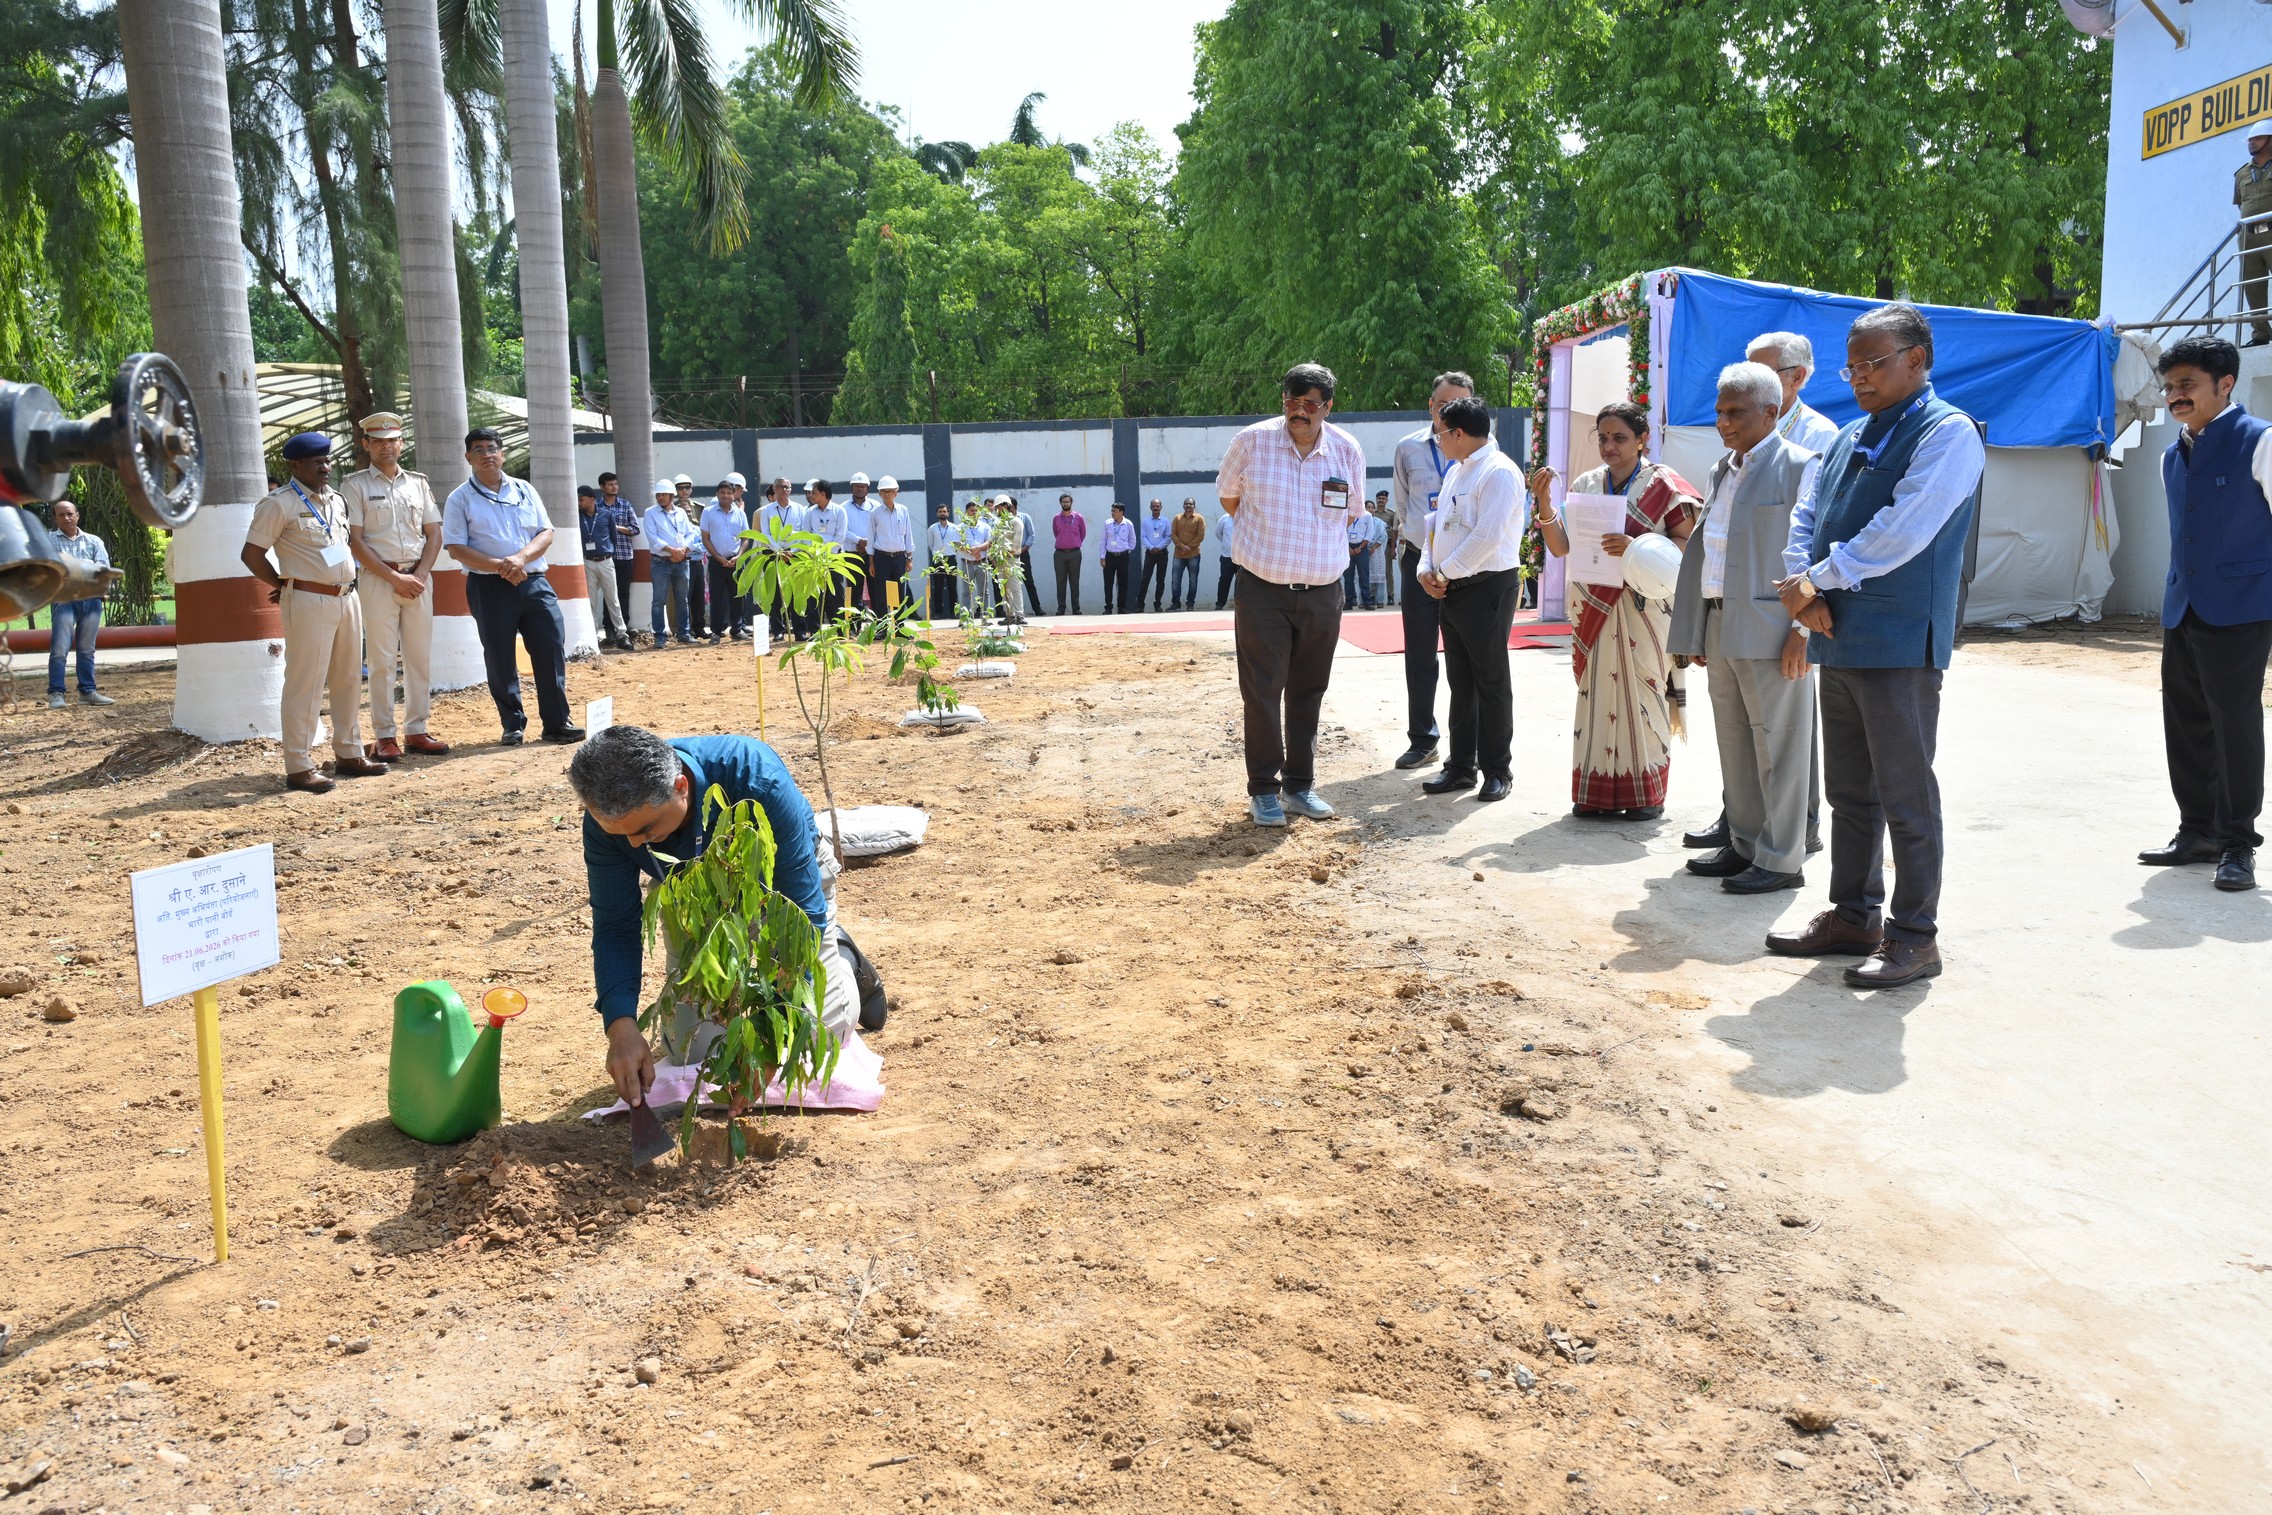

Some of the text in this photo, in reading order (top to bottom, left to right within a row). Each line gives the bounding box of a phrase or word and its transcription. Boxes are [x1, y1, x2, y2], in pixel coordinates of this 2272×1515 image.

[2146, 73, 2272, 152] VDPP BUILDI
[169, 872, 246, 903] श्री ए. आर. दुसाने
[175, 908, 189, 920] मुख्य
[188, 908, 233, 928] भारी पानी बोर्ड
[205, 928, 219, 939] द्वारा
[162, 951, 183, 965] दिनांक
[222, 936, 230, 947] को
[248, 929, 260, 938] गया
